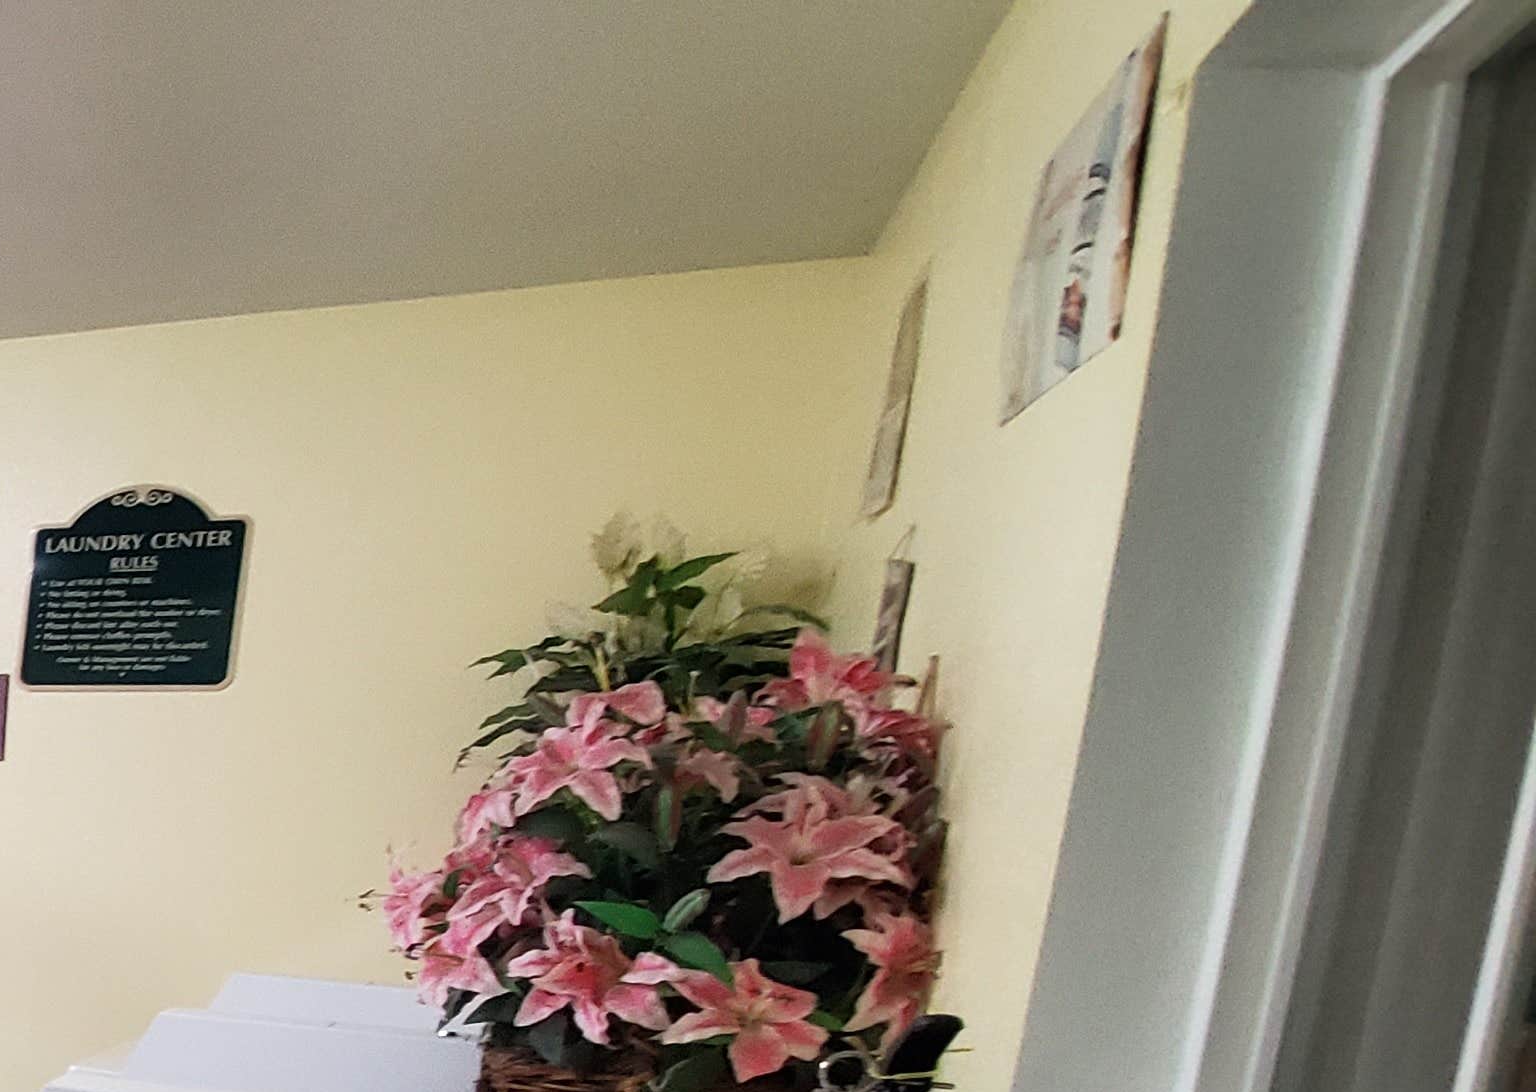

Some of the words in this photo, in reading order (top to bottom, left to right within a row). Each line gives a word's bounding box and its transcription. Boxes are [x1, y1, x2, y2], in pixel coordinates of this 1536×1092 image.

[45, 532, 145, 554] LAUNDRY
[150, 530, 232, 549] CENTER
[109, 555, 159, 571] RULES
